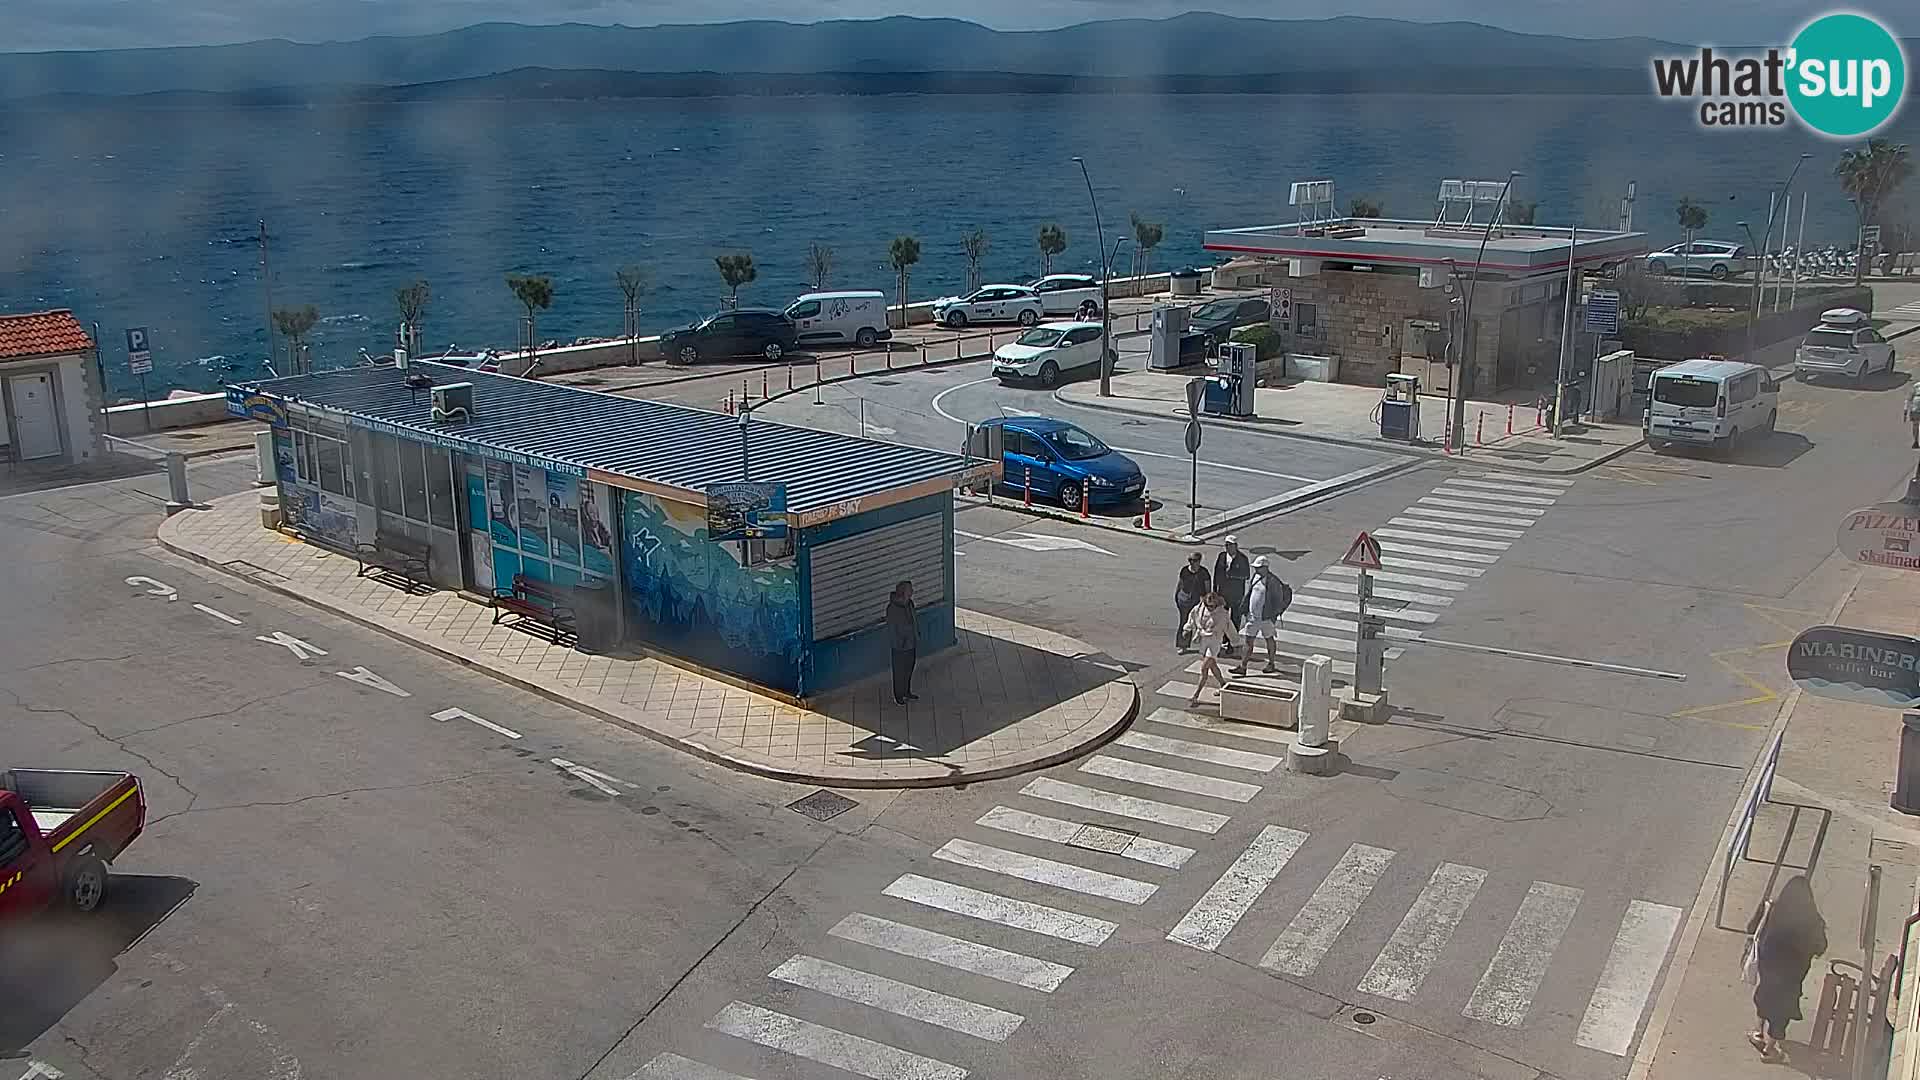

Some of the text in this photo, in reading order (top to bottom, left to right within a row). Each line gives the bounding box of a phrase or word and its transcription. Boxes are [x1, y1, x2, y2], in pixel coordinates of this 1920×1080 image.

[131, 331, 144, 349] P
[495, 449, 527, 465] STATION
[528, 456, 554, 471] TICKET
[556, 463, 583, 476] OFFICE
[1849, 515, 1920, 533] PIZZE
[1869, 664, 1896, 679] bar
